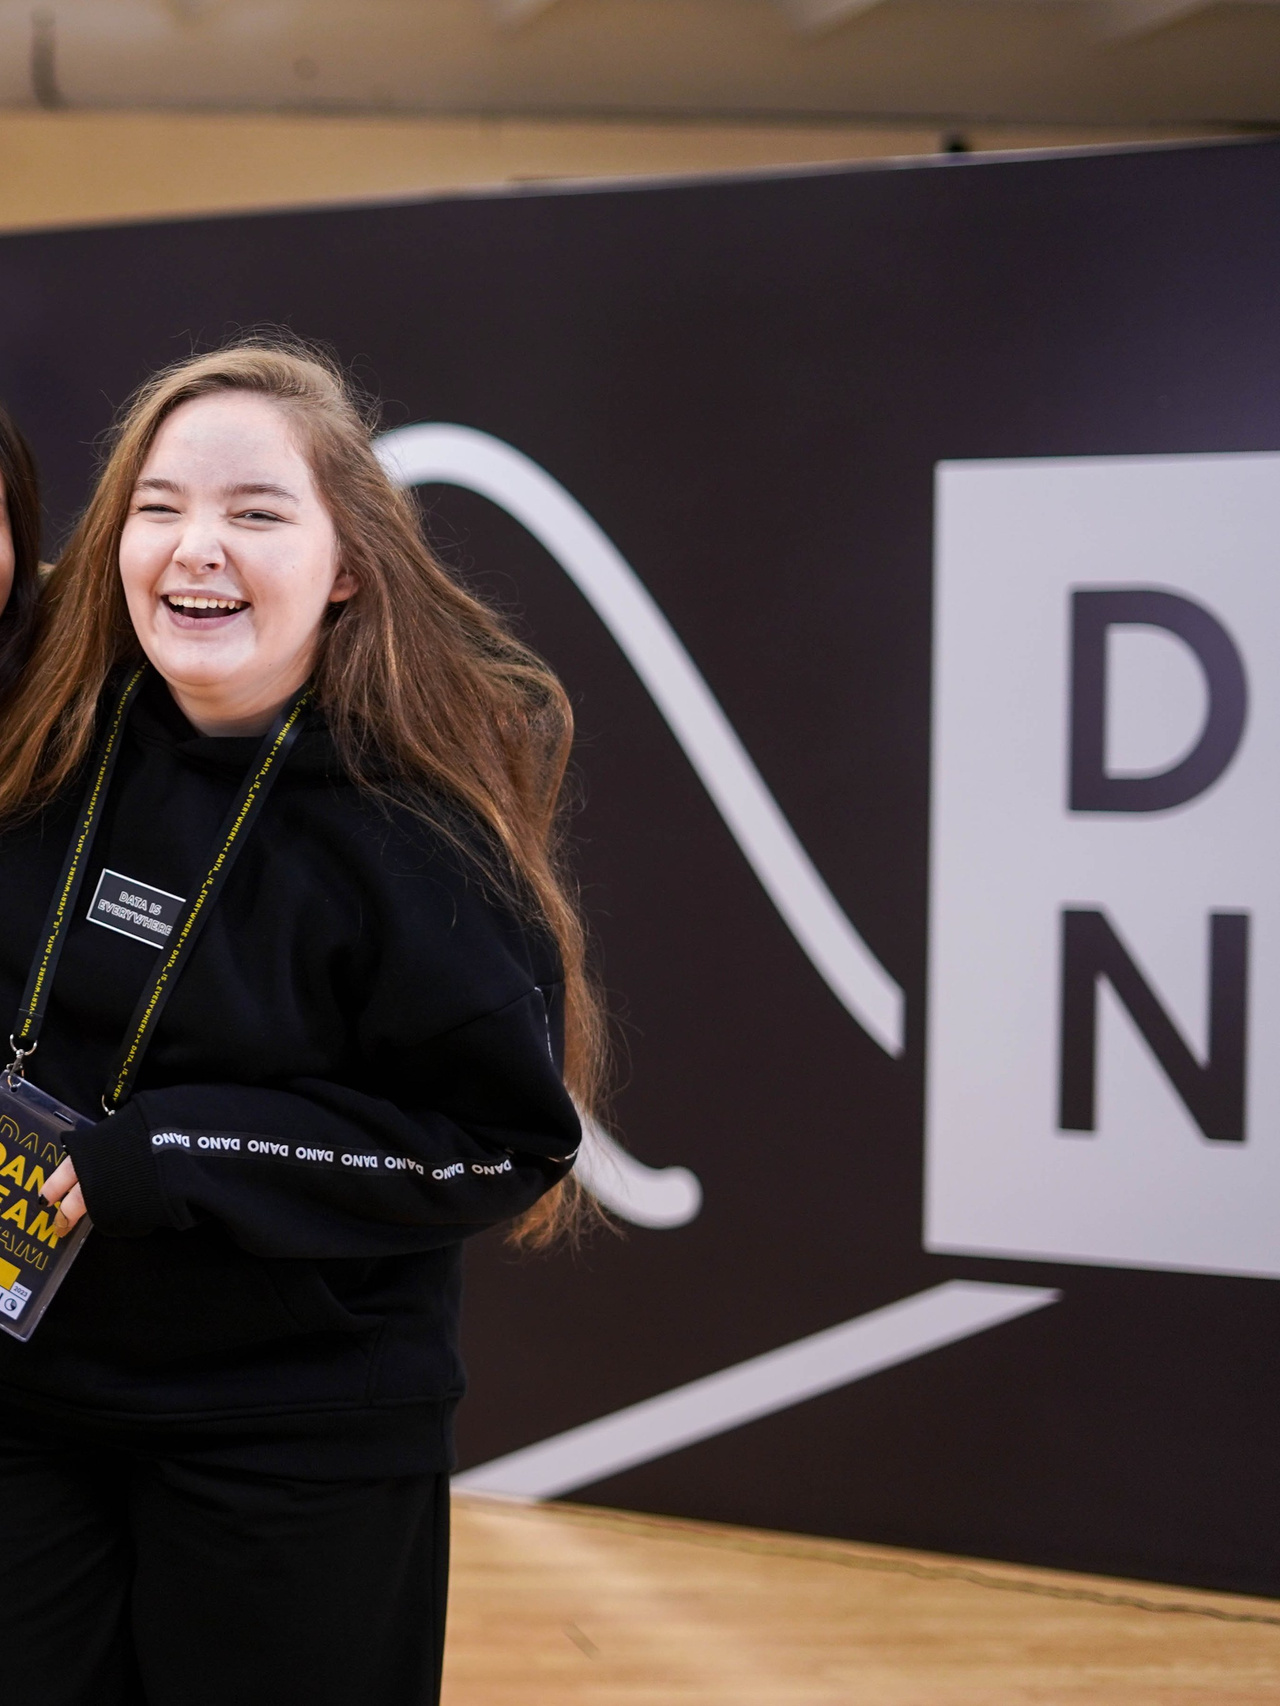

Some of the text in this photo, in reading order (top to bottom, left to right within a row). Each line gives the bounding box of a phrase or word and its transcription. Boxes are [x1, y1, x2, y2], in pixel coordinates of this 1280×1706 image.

[1066, 584, 1250, 816] D
[98, 899, 173, 936] EVERYWHERE
[119, 891, 162, 915] DATA IS
[30, 968, 46, 1016] VERYWHERE
[1058, 906, 1251, 1143] N
[152, 1133, 512, 1180] DANO DANO DANO DANO DANO DANO DANO DANO
[13, 1285, 28, 1297] 2023
